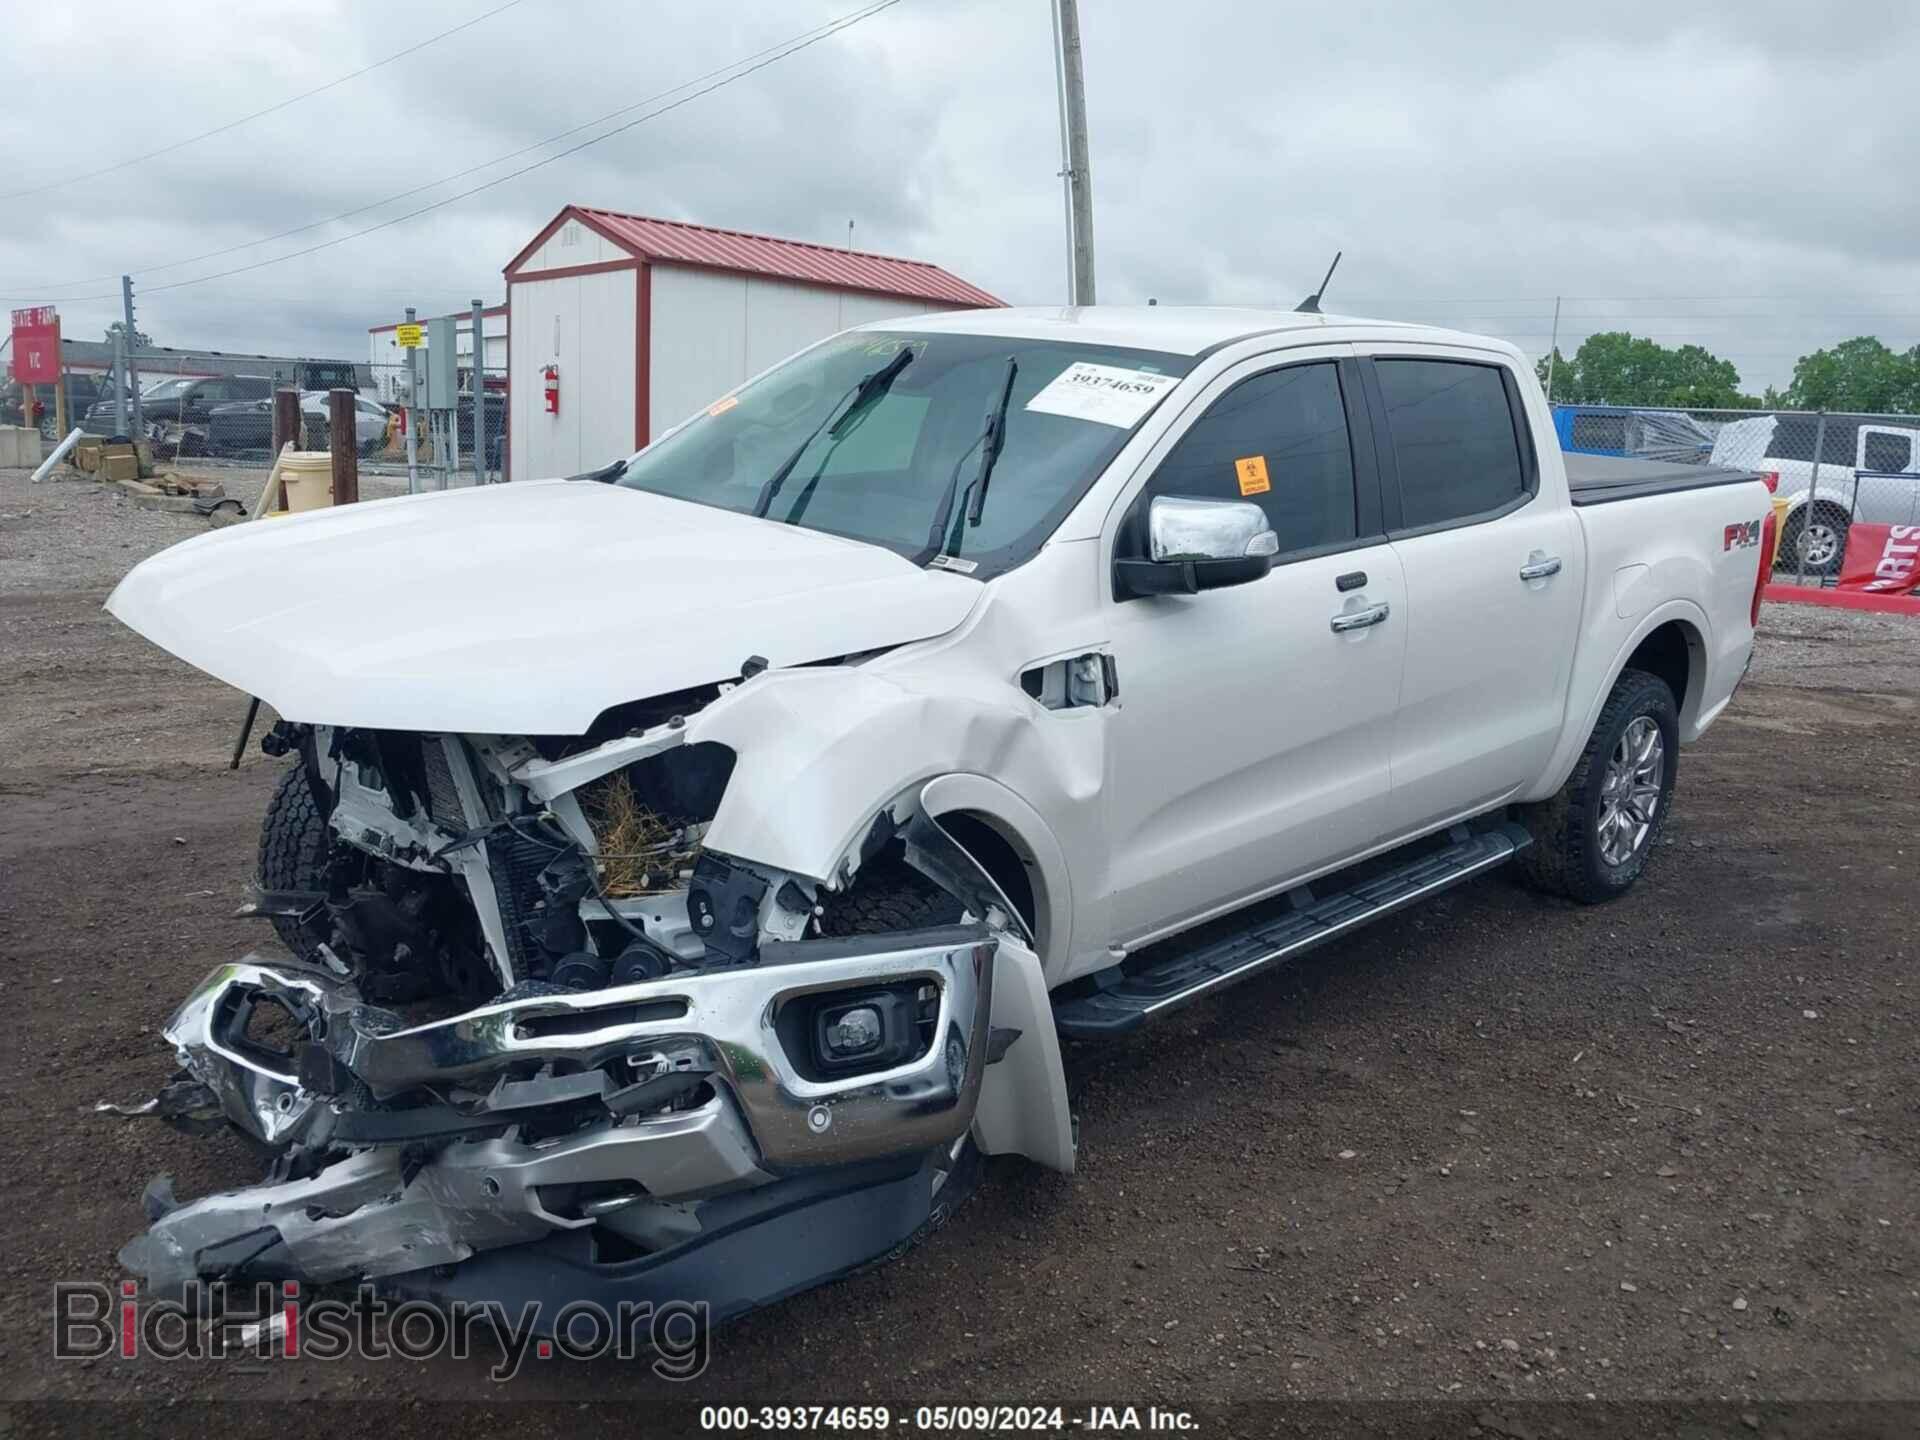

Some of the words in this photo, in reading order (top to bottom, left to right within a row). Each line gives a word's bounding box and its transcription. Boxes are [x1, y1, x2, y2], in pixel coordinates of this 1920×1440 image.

[11, 310, 33, 328] STATE
[1066, 373, 1156, 394] 39374659
[1724, 519, 1760, 552] FX4
